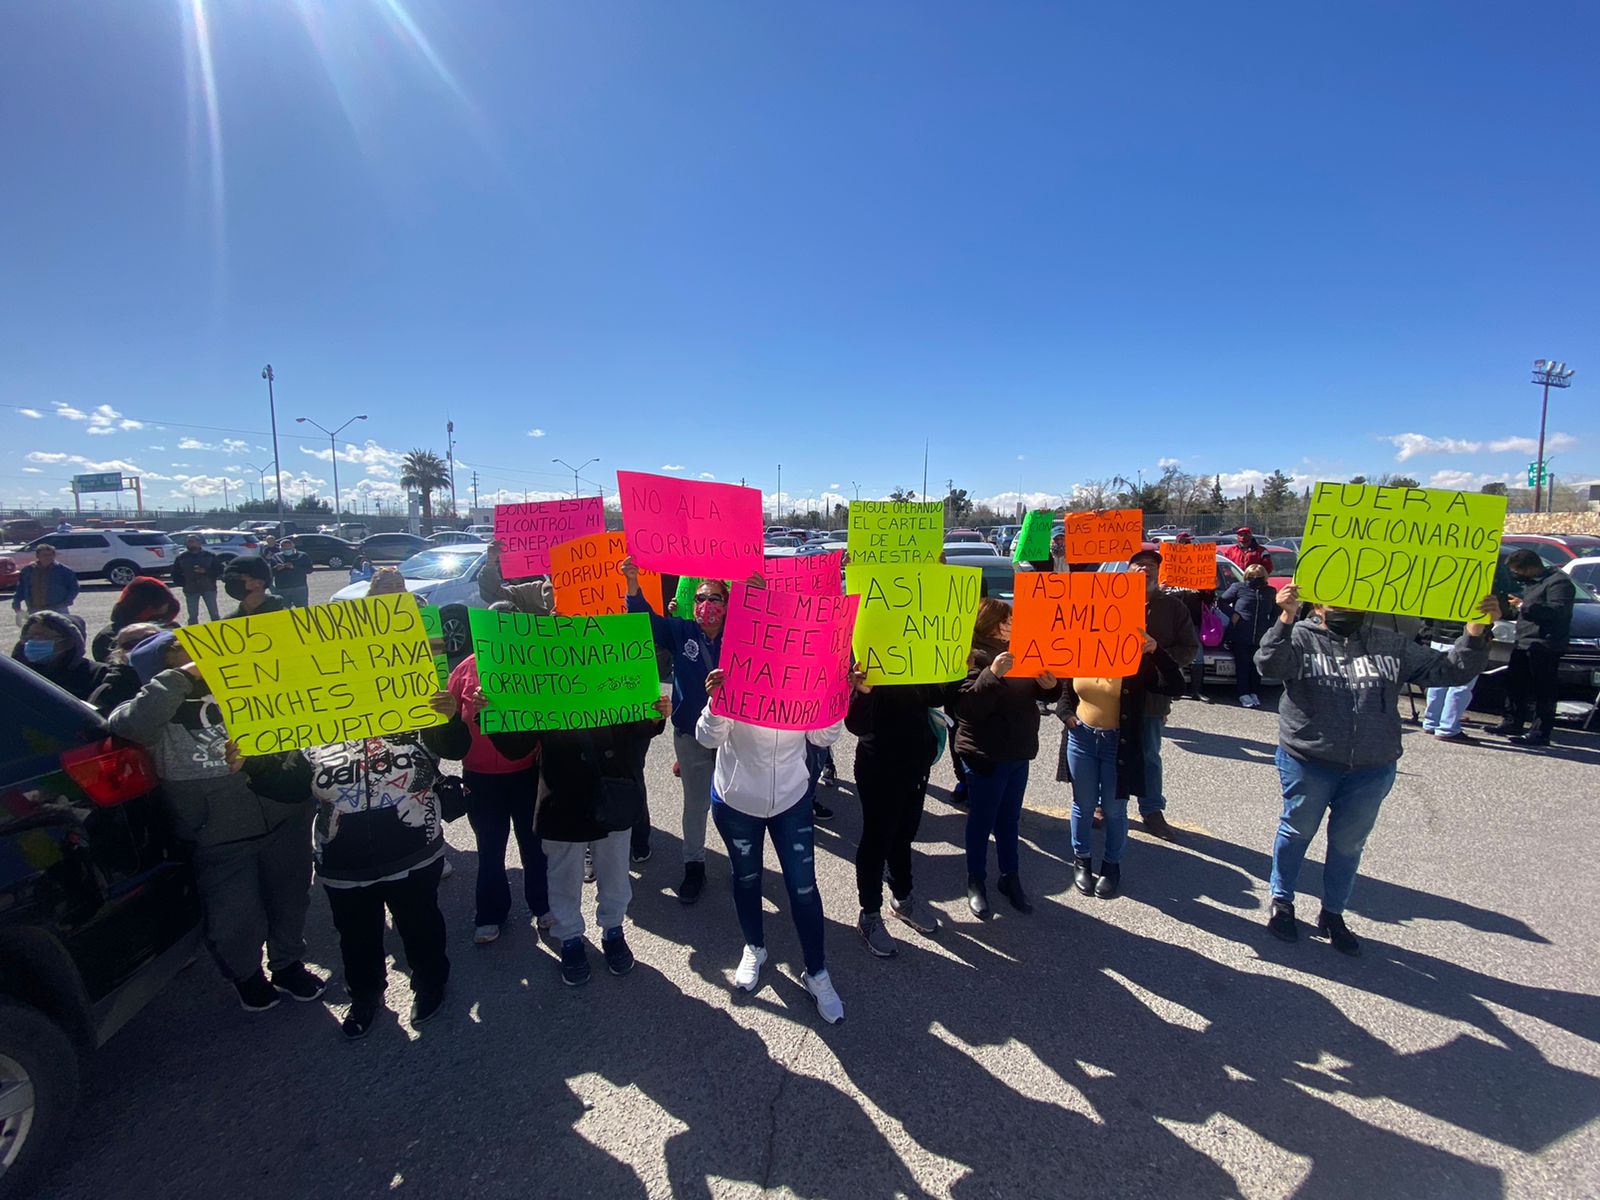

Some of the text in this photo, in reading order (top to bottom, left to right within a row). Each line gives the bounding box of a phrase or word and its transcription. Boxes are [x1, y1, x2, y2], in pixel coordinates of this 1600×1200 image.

[497, 503, 549, 516] DONDE
[631, 486, 662, 514] NO
[852, 501, 944, 514] SIGUE OPERANDO
[1317, 482, 1469, 516] FUERA
[585, 514, 600, 527] MI
[853, 516, 937, 530] EL CARTEL
[1067, 520, 1141, 535] LAS MANOS
[1309, 513, 1499, 553] FUNCIONARIOS
[570, 541, 597, 562] NO
[634, 528, 761, 559] CORRUPCION
[870, 533, 917, 547] DE LA
[1071, 538, 1135, 556] LOERA
[1169, 543, 1188, 553] NOS
[763, 553, 838, 574] EL MERO
[852, 549, 936, 564] MAESTRA
[1164, 552, 1177, 562] EN
[1179, 555, 1193, 564] LA
[553, 559, 657, 590] CORRUPC
[1091, 572, 1130, 600] NO
[1294, 544, 1496, 621] CORRUPTOS
[579, 585, 604, 606] EN
[743, 584, 850, 623] EL MERO
[945, 574, 977, 615] NO
[181, 594, 415, 660] NOS MORIMOS
[496, 612, 605, 638] FUERA
[902, 614, 962, 642] AMLO
[1050, 603, 1122, 633] AMLO
[739, 620, 821, 656] JEFE
[1020, 633, 1140, 669] ASI NO
[218, 639, 433, 690] EN LA RAYA
[475, 639, 655, 668] FUNCIONARIOS
[865, 640, 964, 677] ASÍ NO
[1300, 653, 1347, 678] ENICE
[480, 671, 588, 695] CORRUPTOS
[728, 652, 828, 691] MAFIA
[225, 683, 355, 724] PINCHES
[375, 670, 440, 703] PUTOS
[715, 685, 821, 725] ALEJANDRO
[234, 704, 438, 753] CORRUPTOS
[483, 700, 663, 734] EXTORSIONADORES
